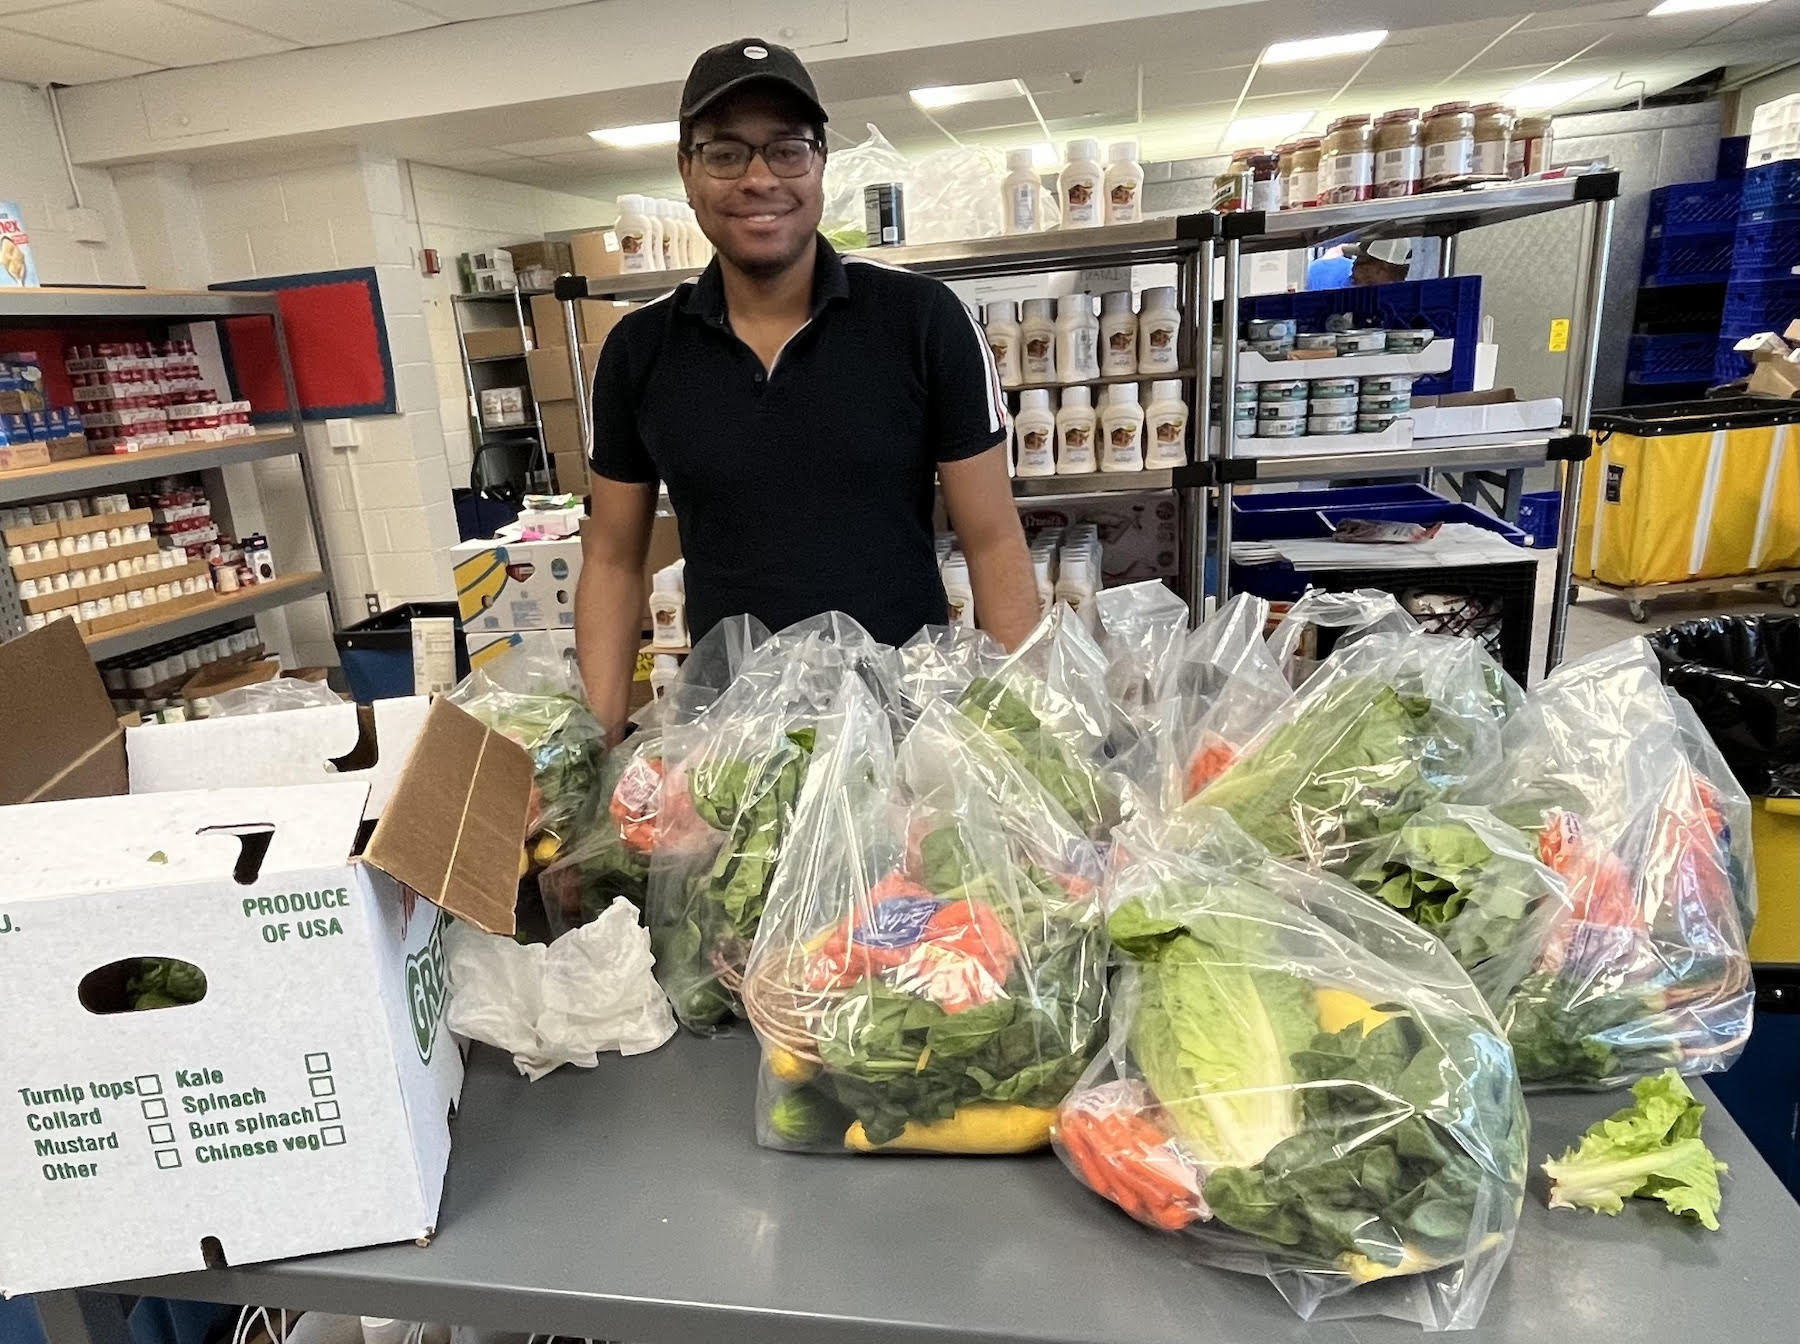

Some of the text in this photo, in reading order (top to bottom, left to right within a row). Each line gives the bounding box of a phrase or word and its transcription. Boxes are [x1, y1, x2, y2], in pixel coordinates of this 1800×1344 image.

[242, 887, 350, 917] PRODUCE
[262, 917, 343, 943] OF USA
[175, 1067, 224, 1088] Kale
[18, 1080, 136, 1106] Turnip tops
[182, 1087, 267, 1115] Spinach
[26, 1107, 102, 1131] Collard
[189, 1106, 315, 1139] Bun spinach
[34, 1131, 119, 1156] Mustard
[195, 1134, 320, 1163] Chinese veg
[42, 1163, 98, 1181] Other
